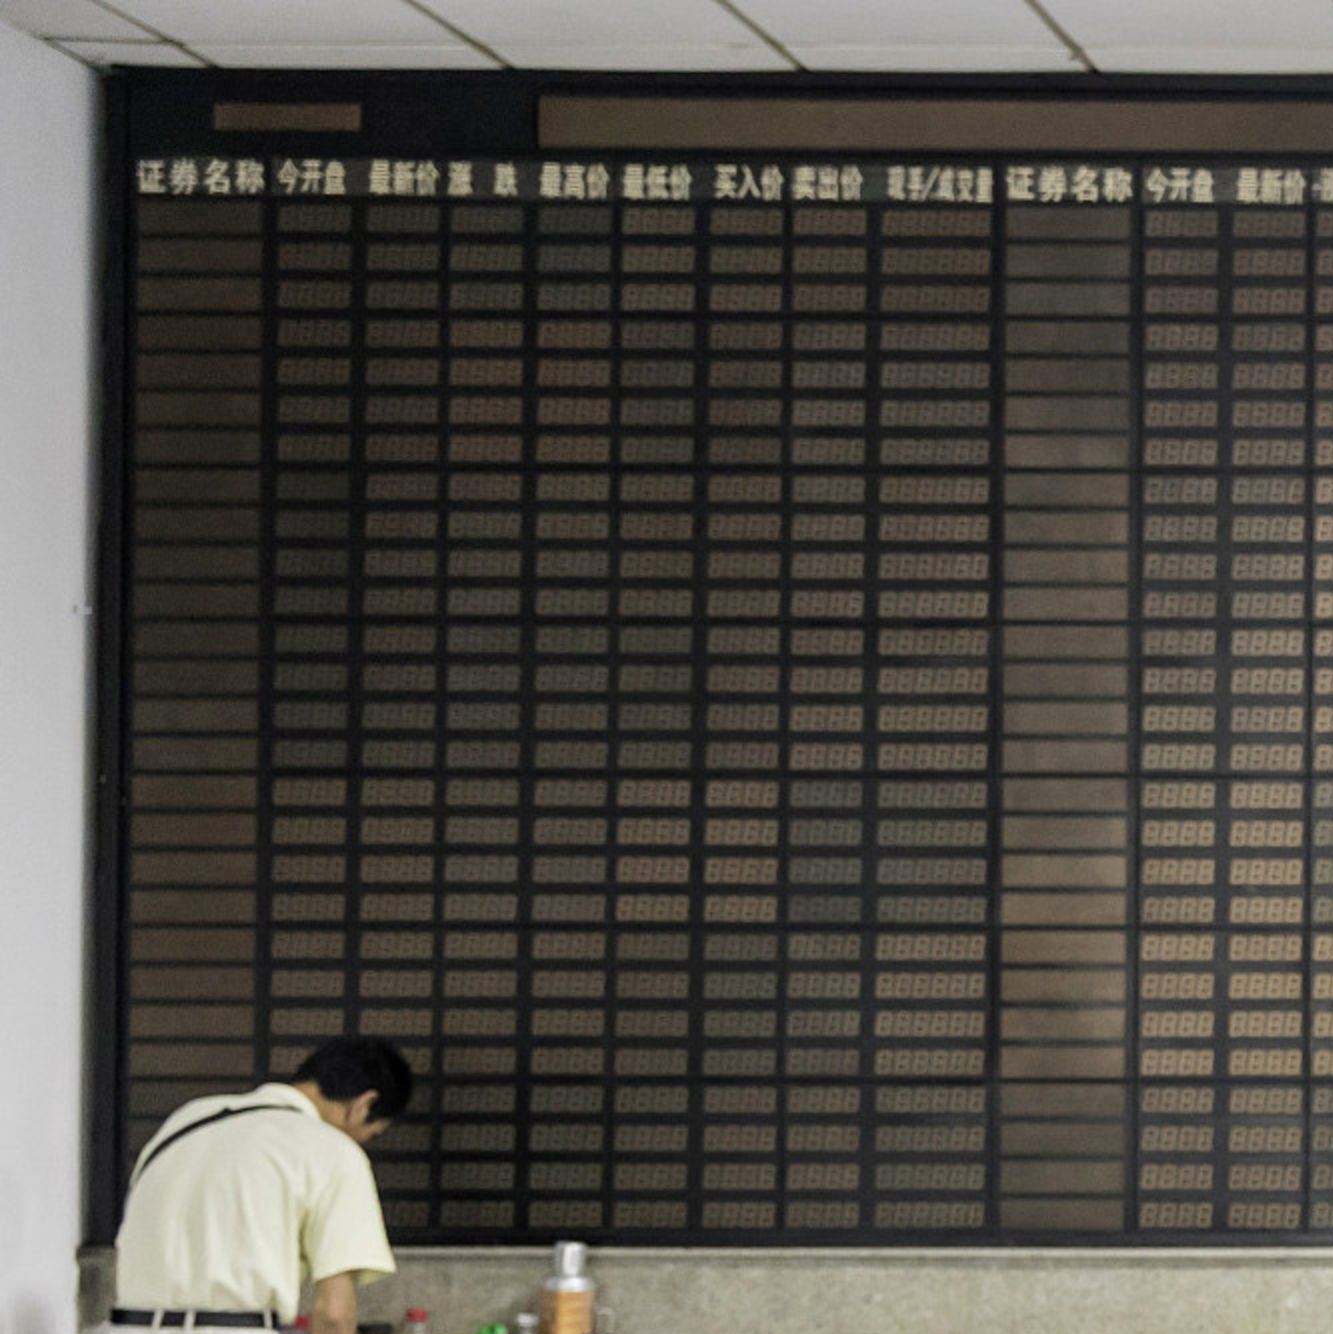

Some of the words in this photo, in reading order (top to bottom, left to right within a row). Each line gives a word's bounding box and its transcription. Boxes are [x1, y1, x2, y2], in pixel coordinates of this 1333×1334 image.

[138, 161, 267, 194] 证券名称
[279, 159, 346, 195] 今开盘
[369, 160, 438, 195] 最新价
[540, 164, 609, 199] 最高价
[622, 165, 692, 200] 最低价
[715, 165, 784, 200] 买入价
[793, 165, 864, 200] 卖出价
[1005, 165, 1133, 203] 证券名称
[1145, 167, 1215, 204] 今开盘
[1236, 167, 1307, 205] 最新价
